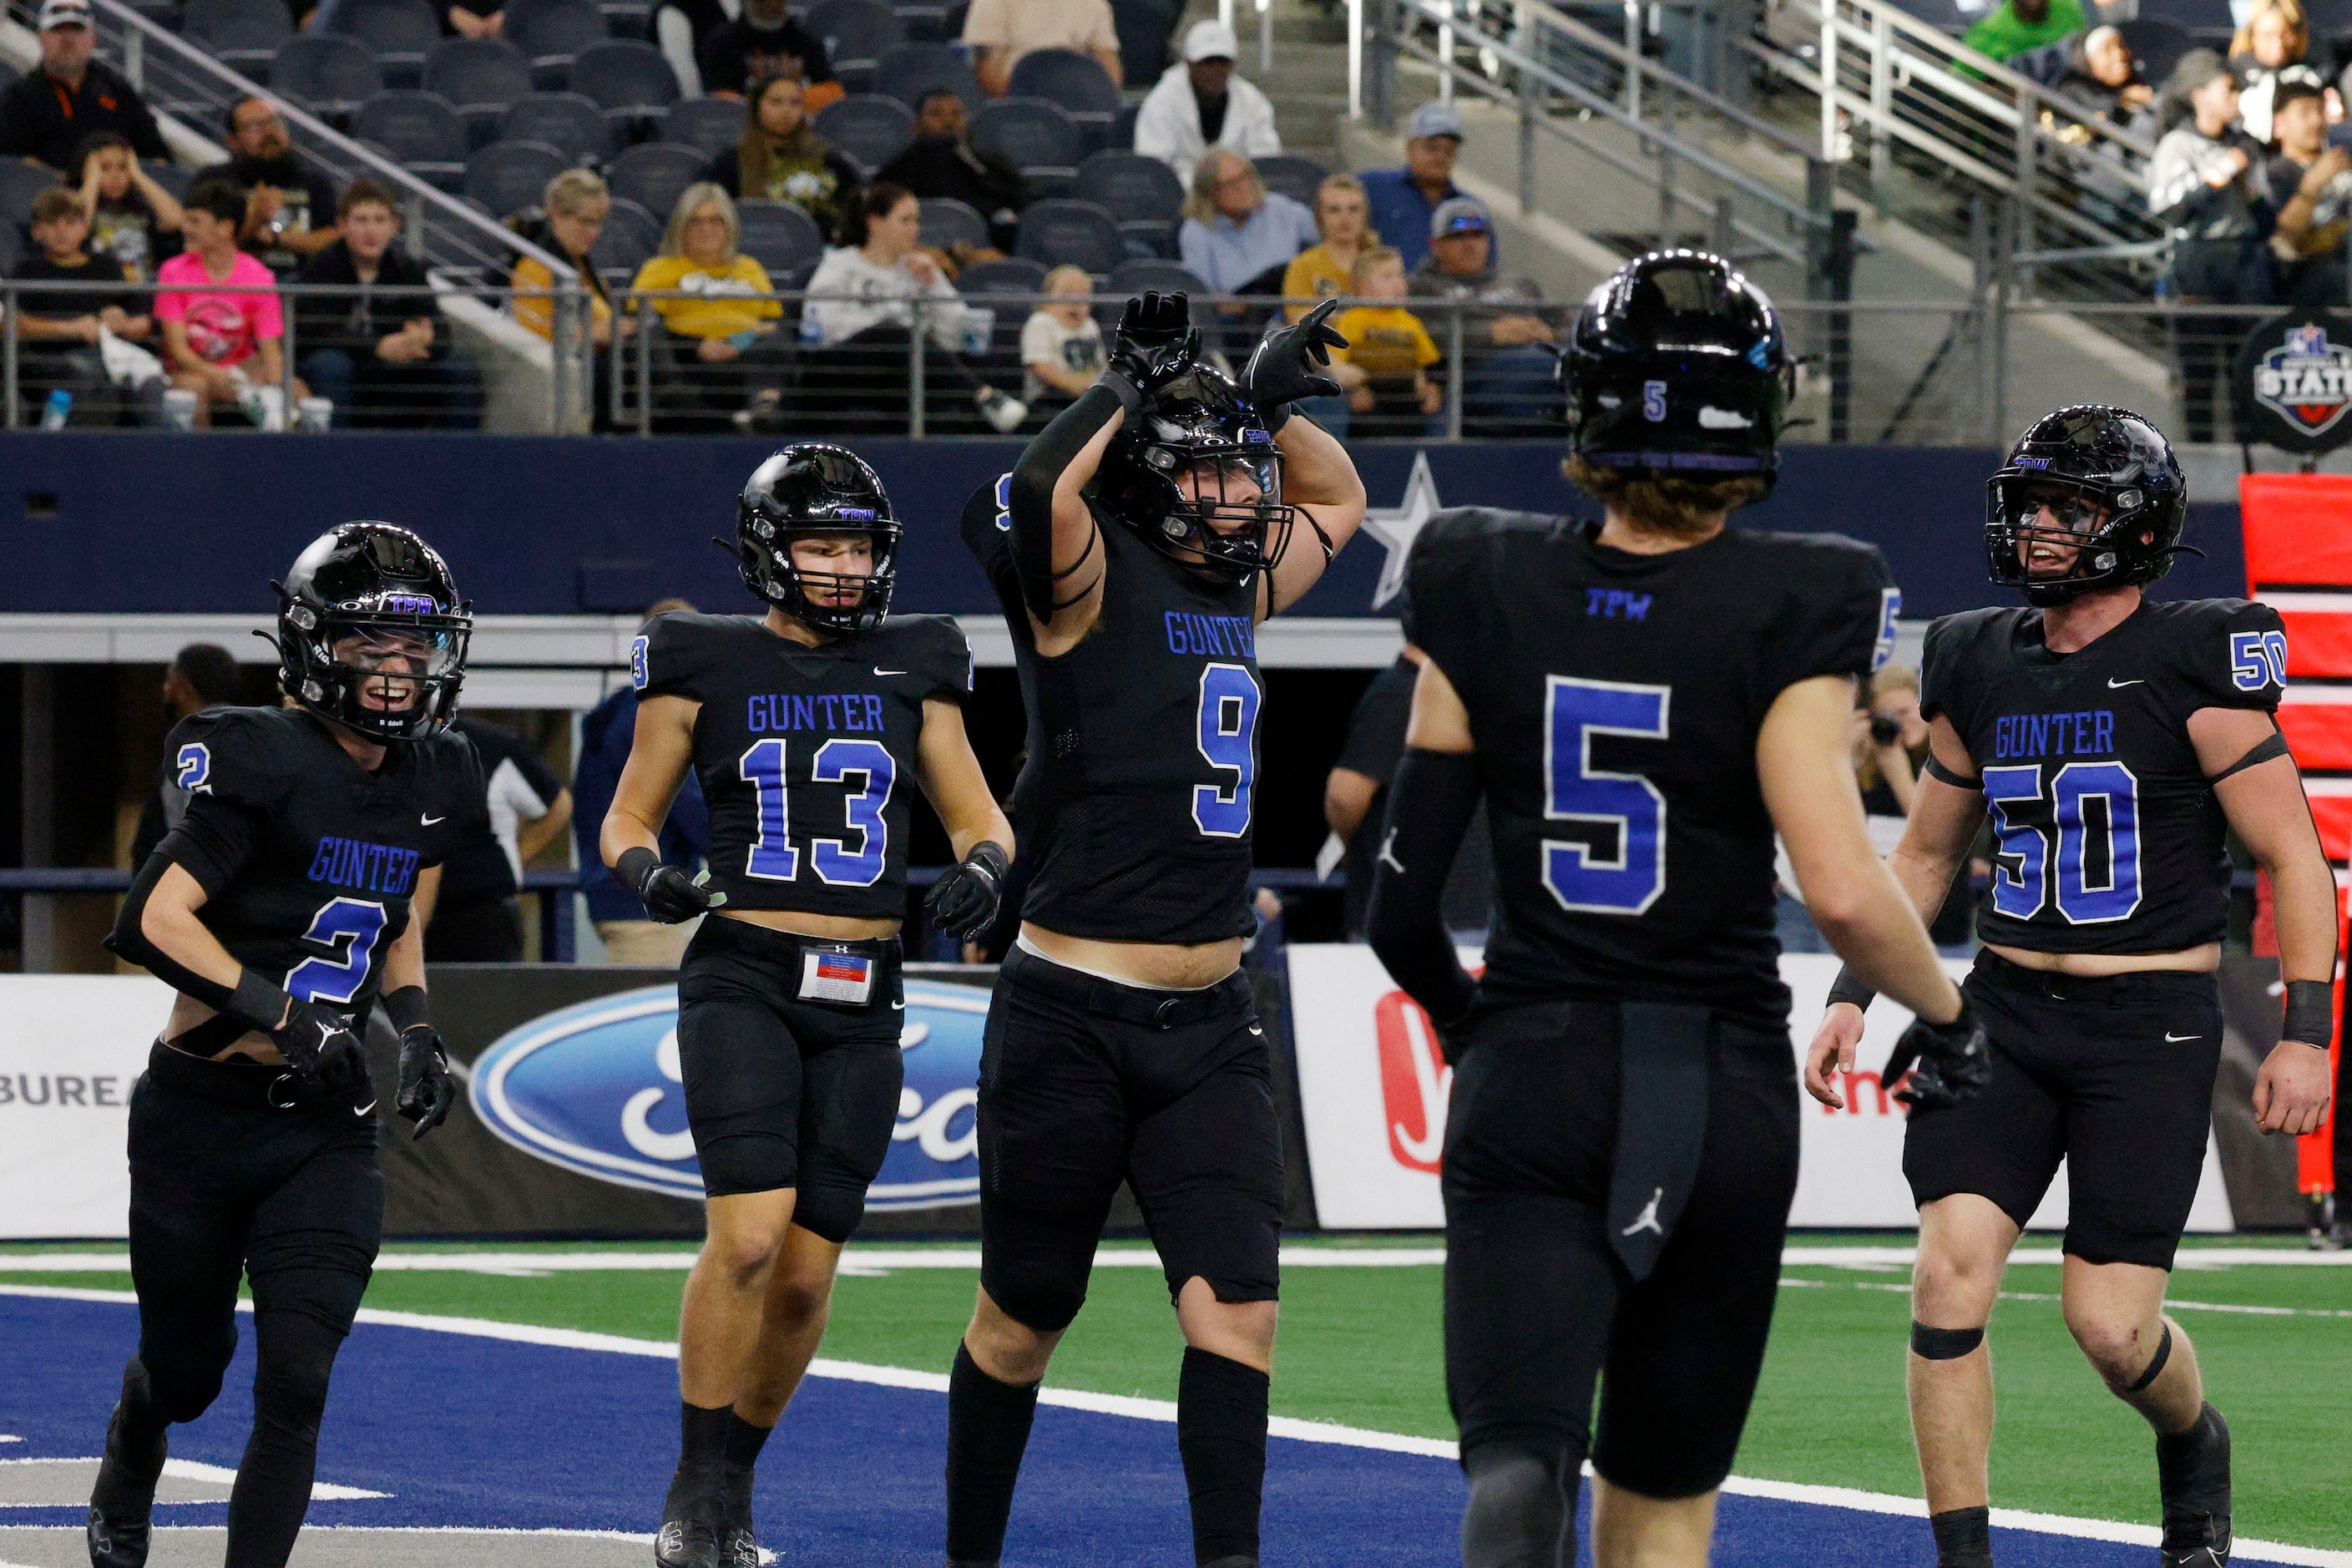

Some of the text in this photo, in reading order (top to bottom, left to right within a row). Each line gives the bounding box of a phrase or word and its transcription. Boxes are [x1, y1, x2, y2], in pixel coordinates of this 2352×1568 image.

[1643, 380, 1667, 422] 5
[390, 595, 432, 614] TPW
[1586, 587, 1653, 621] TPW
[2229, 630, 2289, 692] 50
[747, 694, 886, 732] GUNTER
[1995, 710, 2115, 759] GUNTER
[177, 741, 215, 797] 2
[1191, 662, 1261, 838] 9
[739, 738, 897, 888] 13
[1541, 674, 1672, 917] 5
[307, 836, 421, 895] GUNTER
[1981, 761, 2143, 925] 50
[282, 895, 389, 1024] 2
